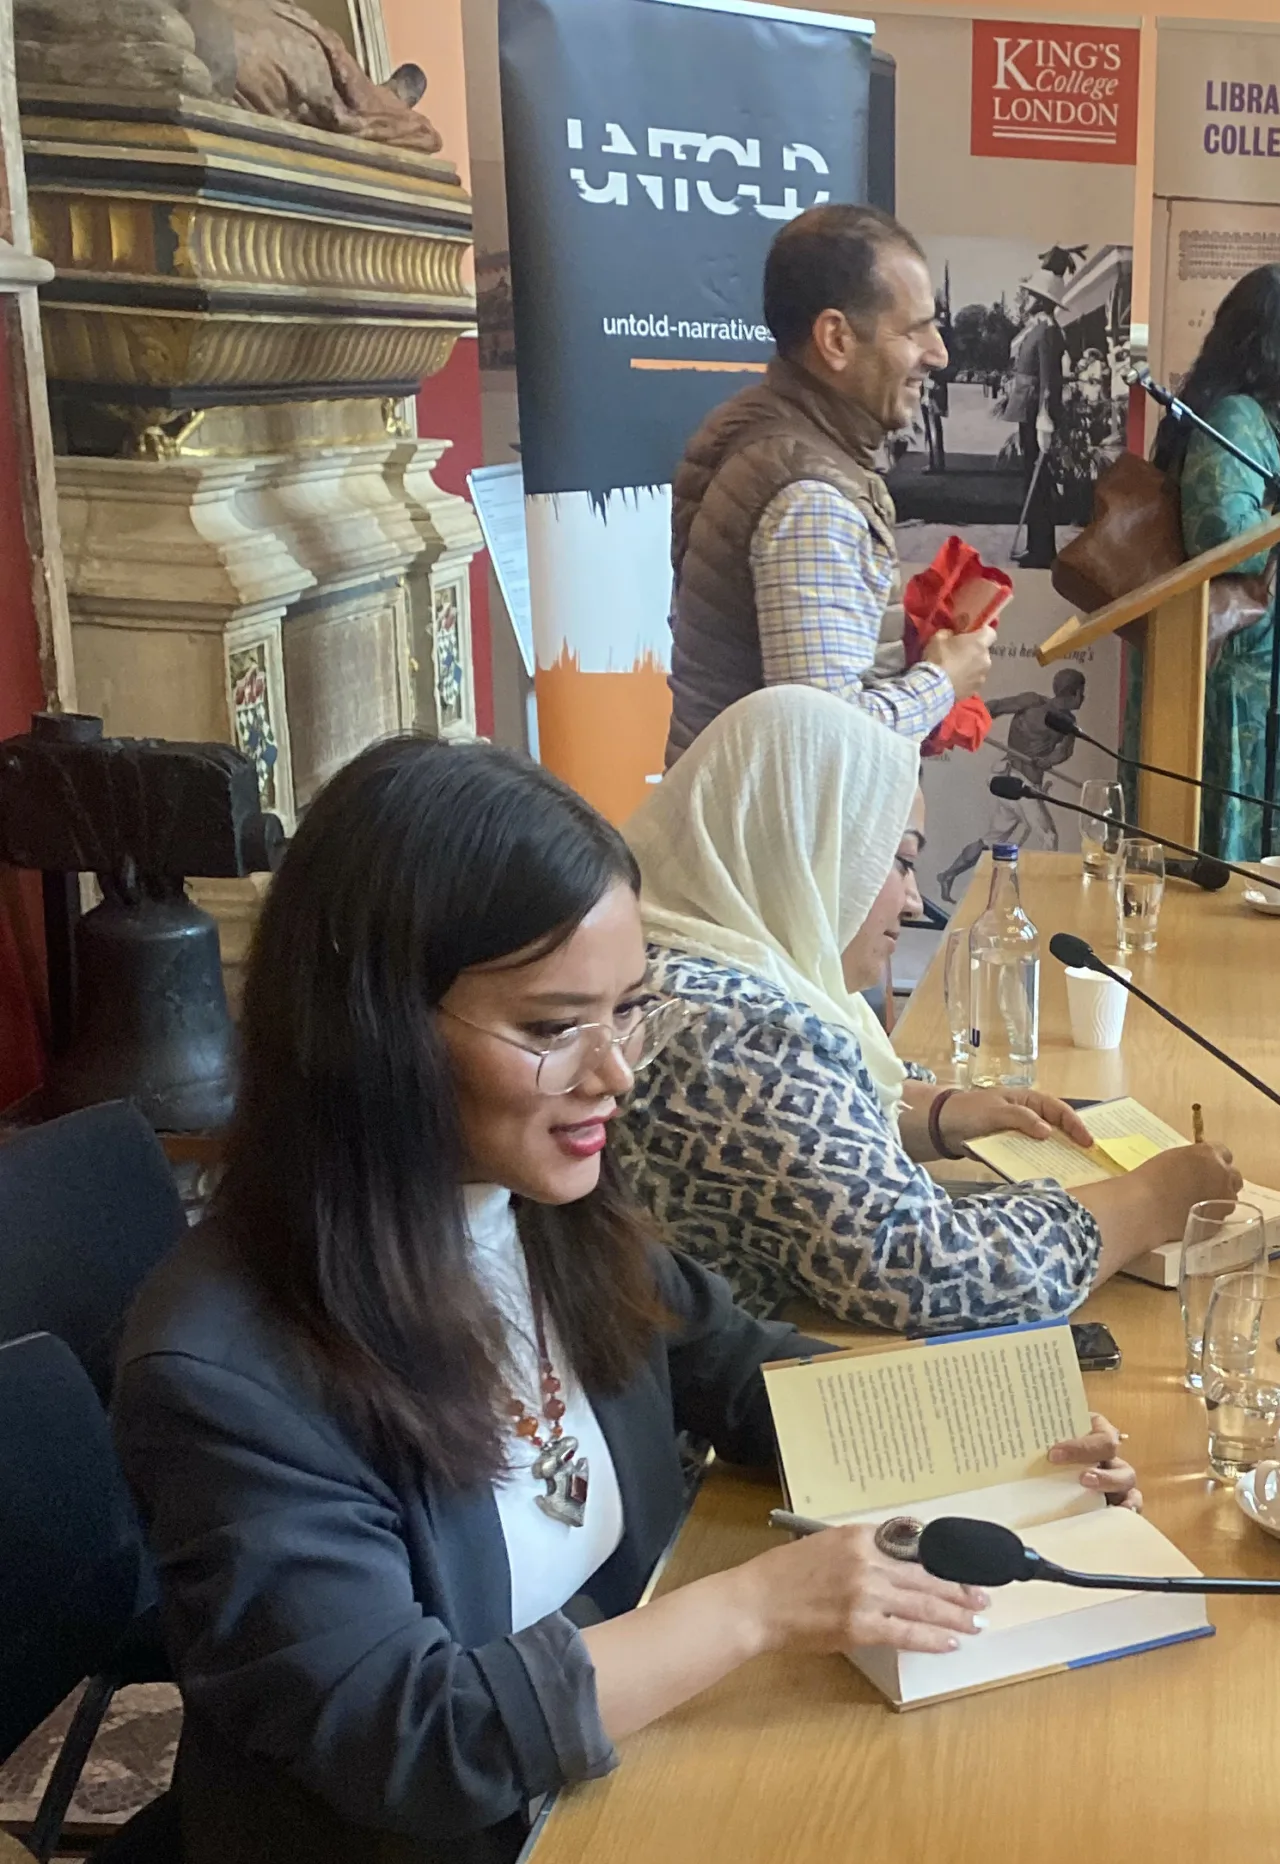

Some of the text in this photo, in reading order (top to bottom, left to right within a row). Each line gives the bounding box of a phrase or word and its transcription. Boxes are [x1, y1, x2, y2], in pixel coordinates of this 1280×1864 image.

[992, 36, 1122, 92] KING'S
[1035, 68, 1120, 100] College
[992, 96, 1120, 127] LONDON
